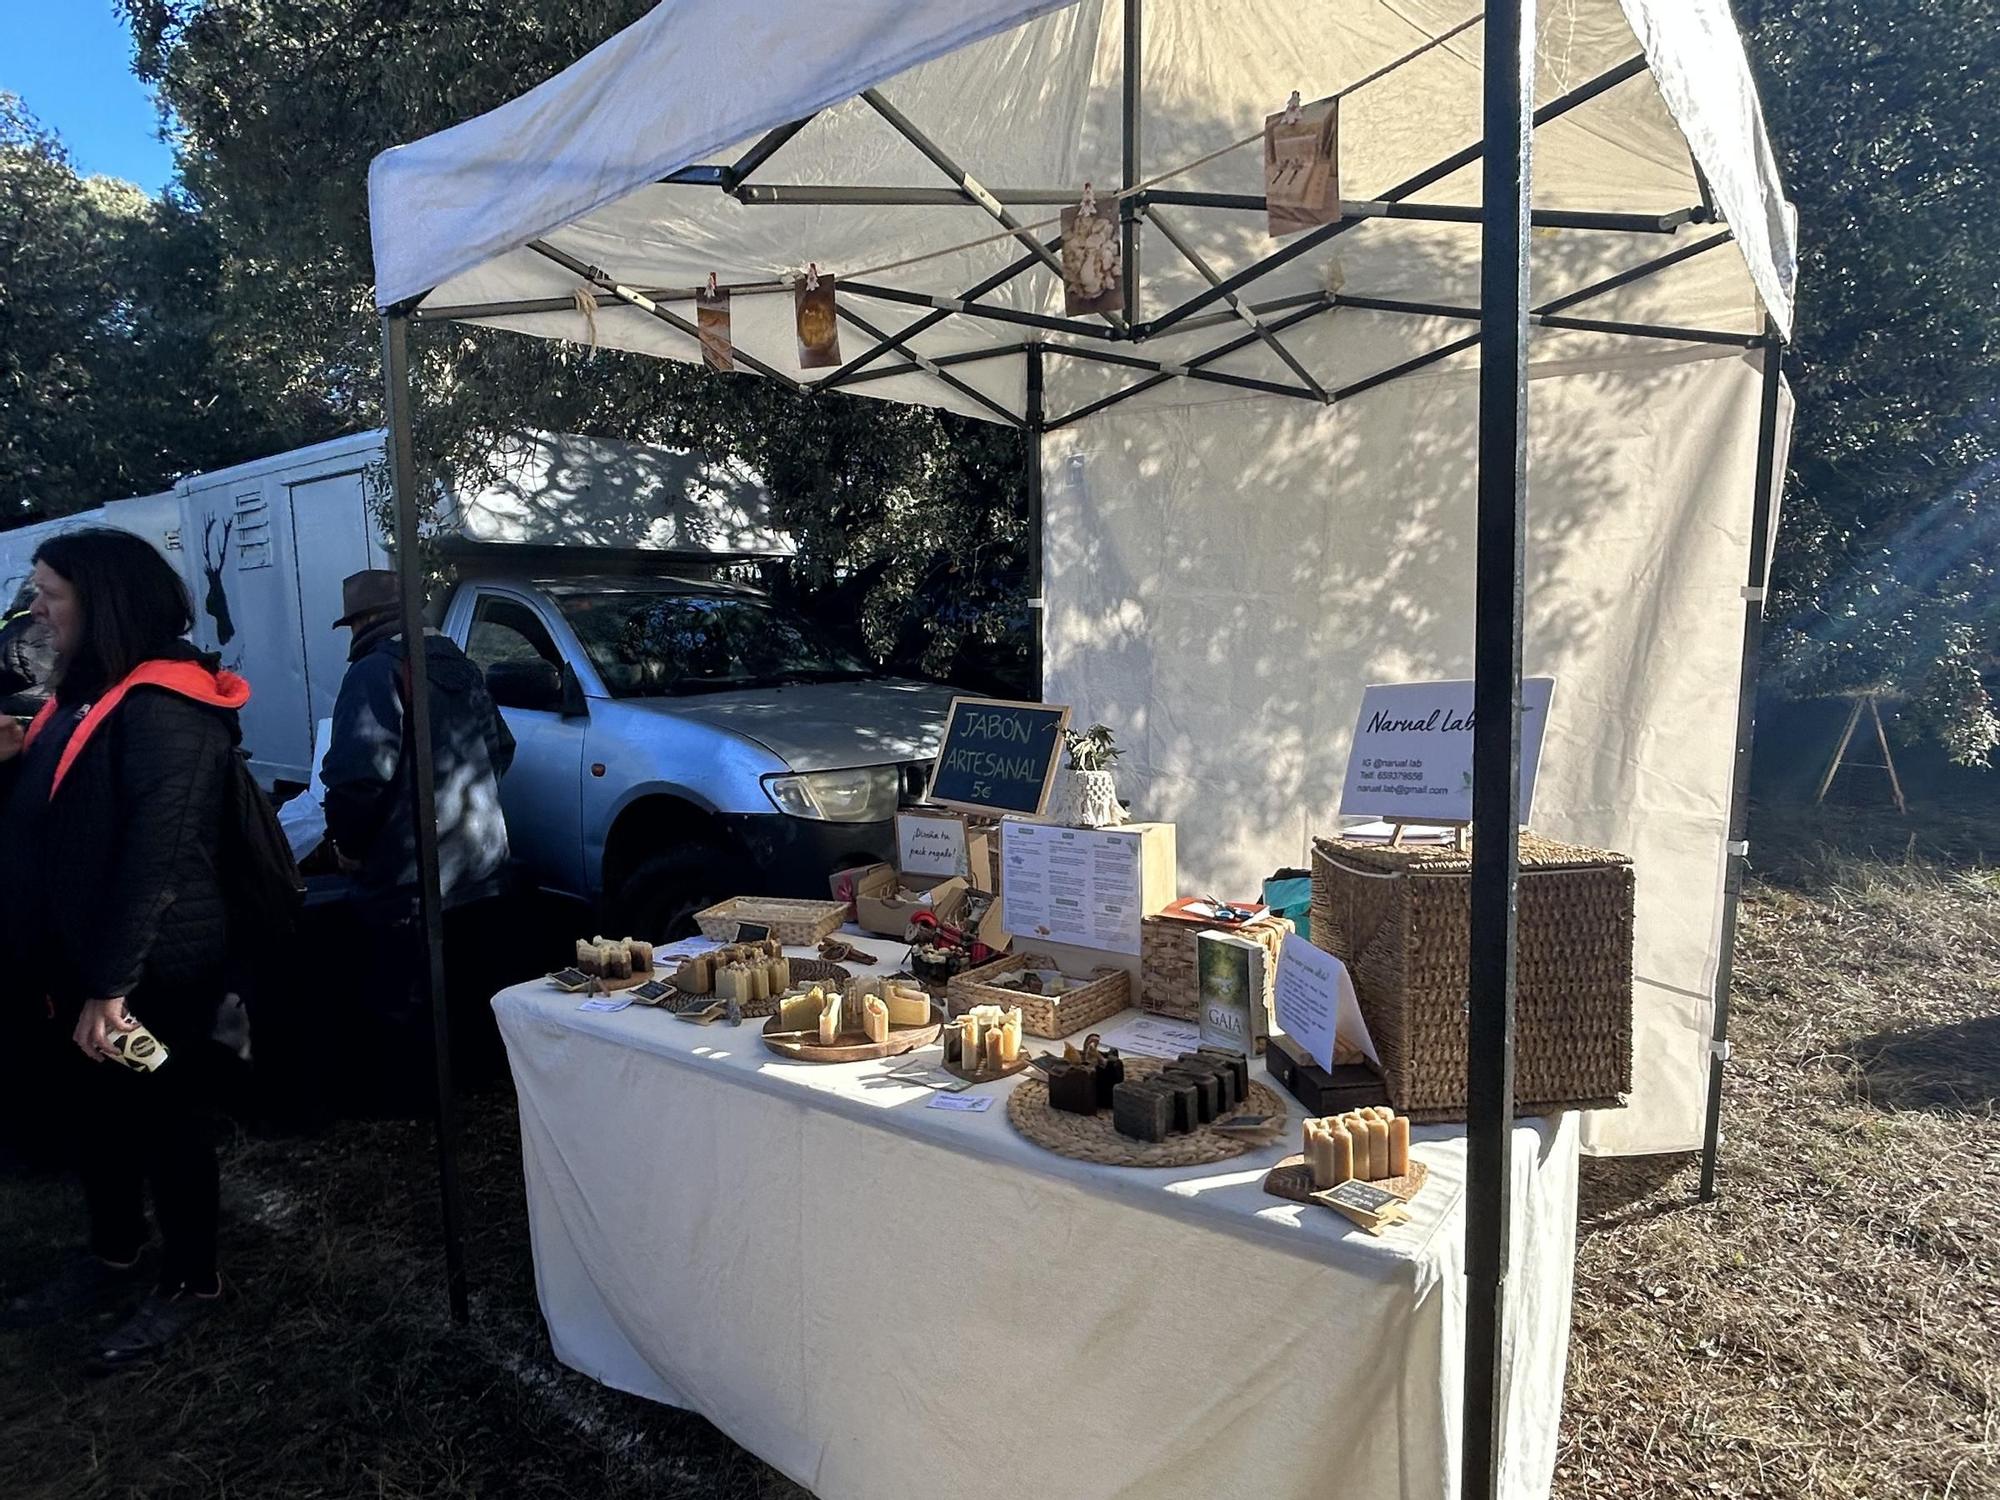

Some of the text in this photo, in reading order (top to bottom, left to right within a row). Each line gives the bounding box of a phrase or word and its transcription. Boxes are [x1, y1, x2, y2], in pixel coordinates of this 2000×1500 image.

[959, 711, 1033, 744] JABÓN
[1367, 709, 1440, 733] Narual
[943, 751, 1042, 783] ARTESANAL
[1362, 758, 1372, 768] IG
[970, 781, 992, 798] 5€
[940, 830, 951, 840] tu
[909, 847, 927, 859] pack
[1208, 1008, 1242, 1034] GAIA
